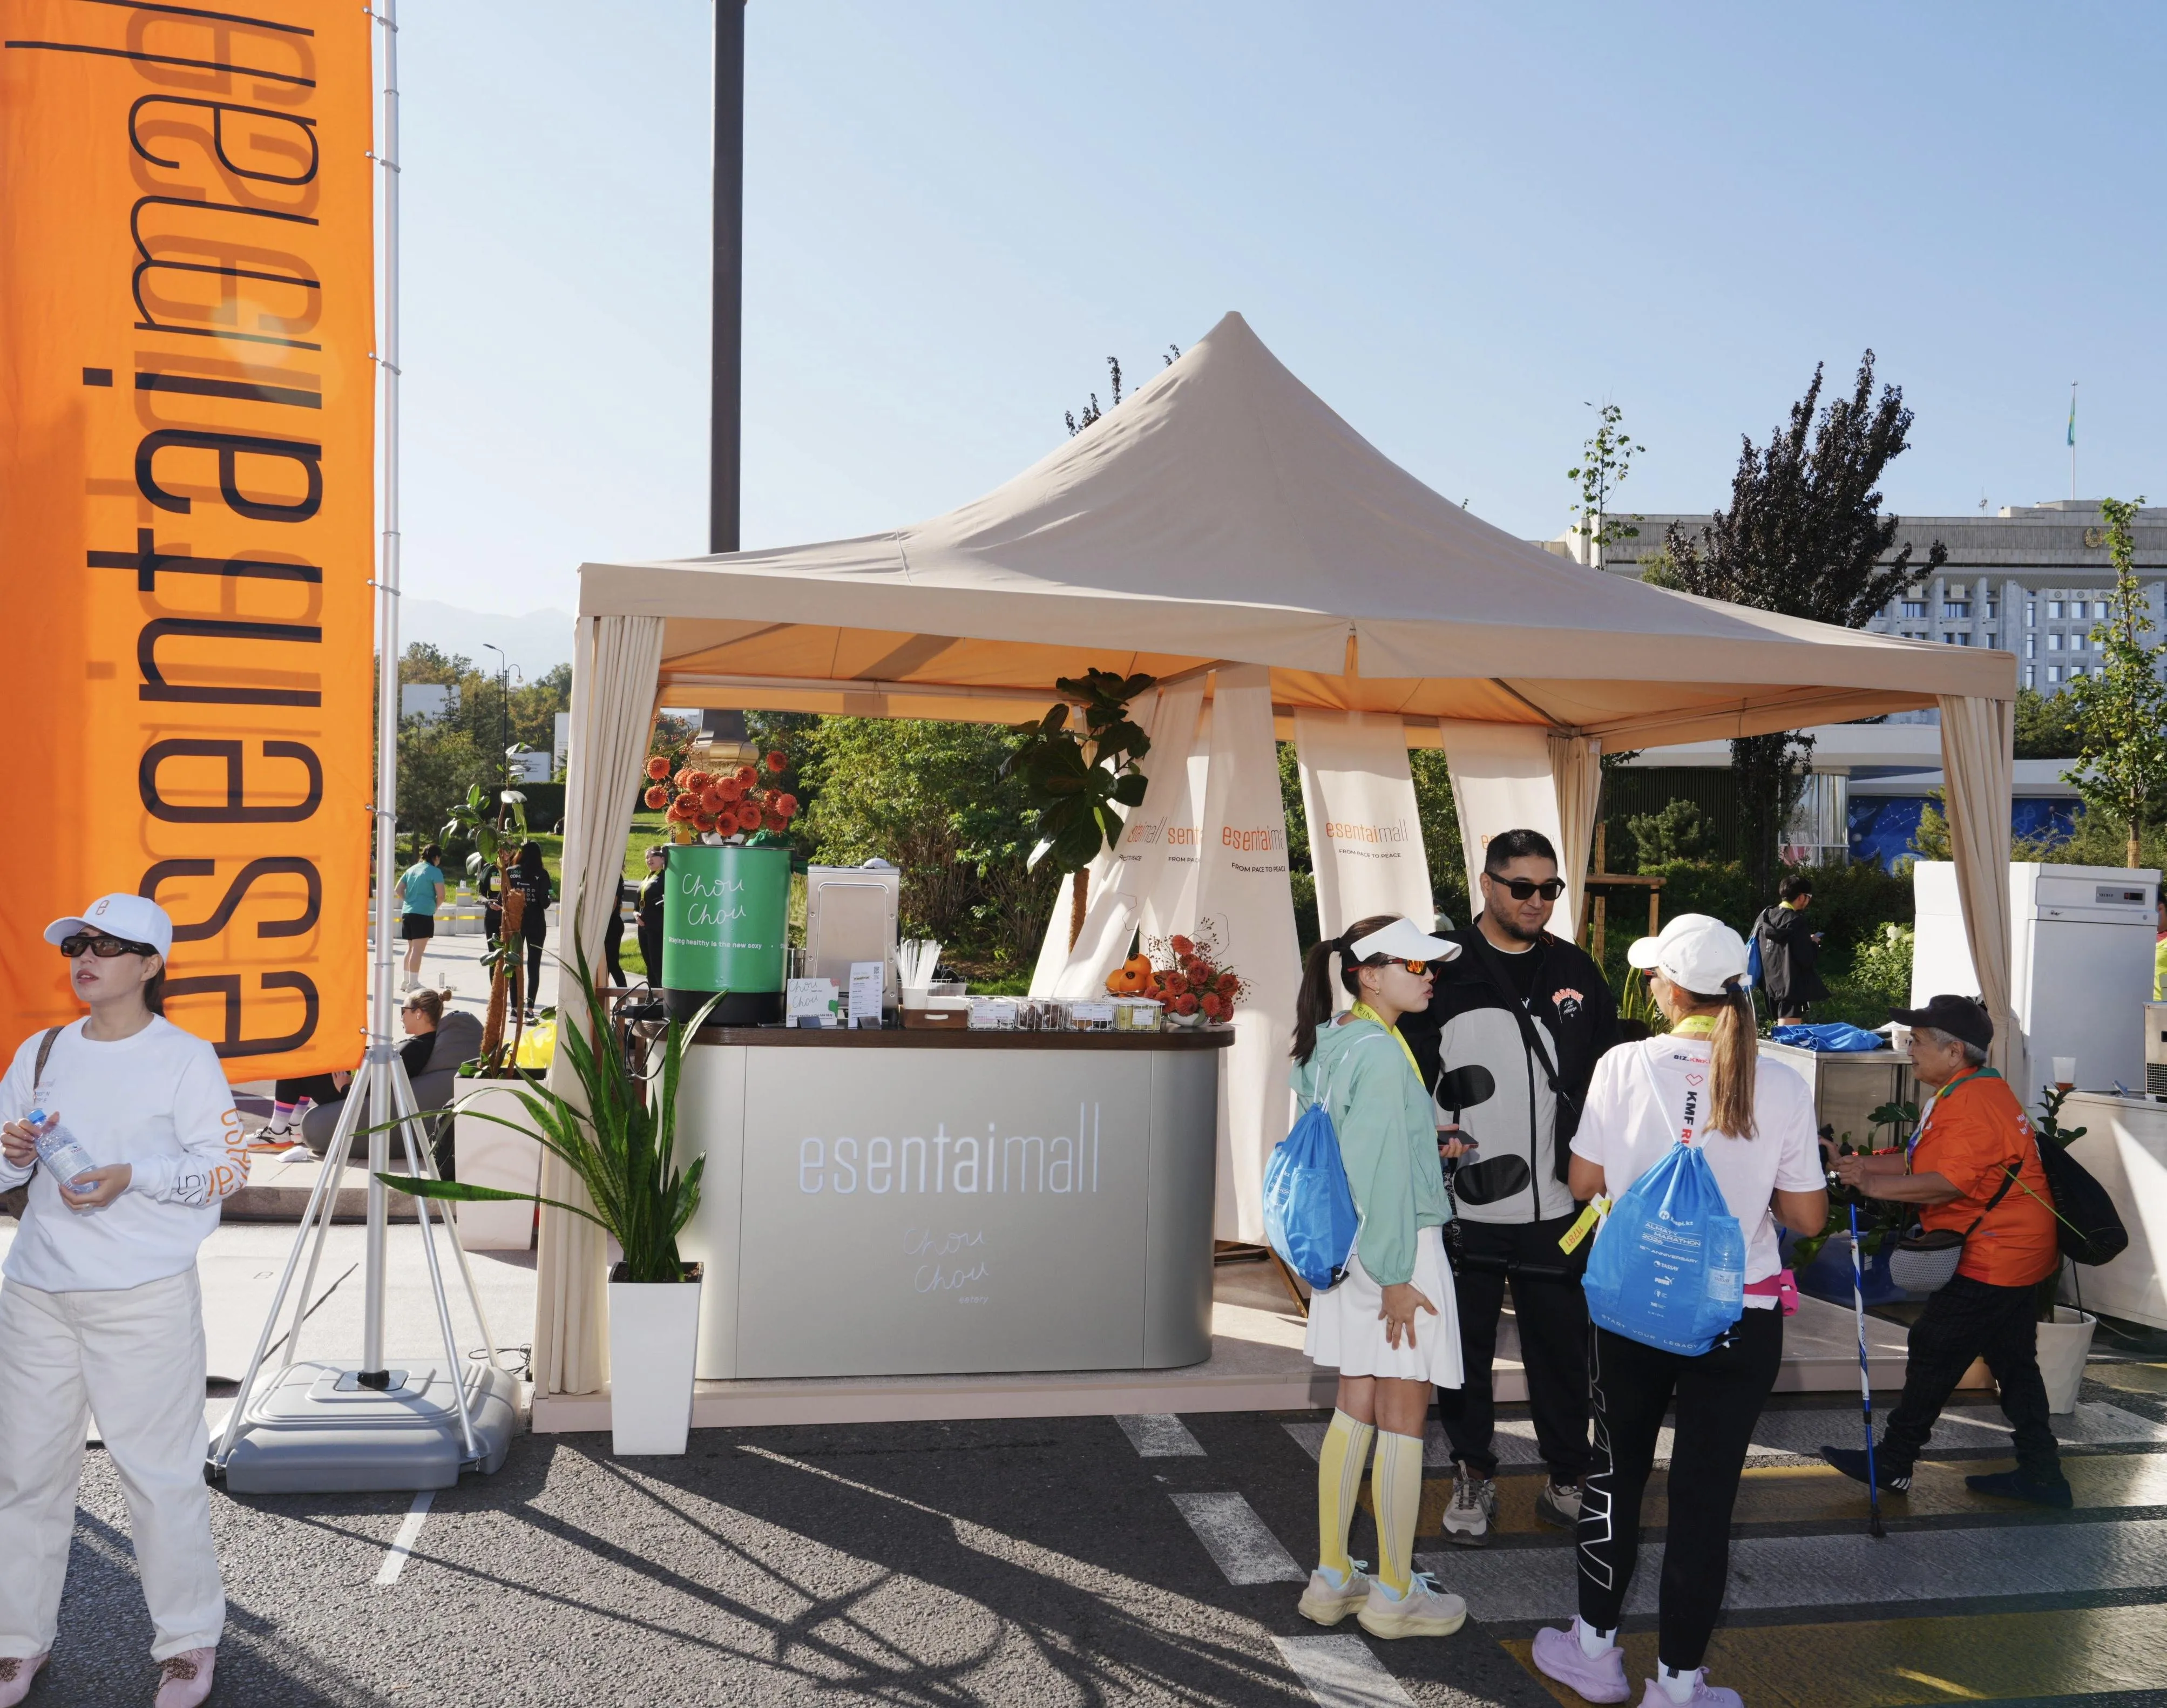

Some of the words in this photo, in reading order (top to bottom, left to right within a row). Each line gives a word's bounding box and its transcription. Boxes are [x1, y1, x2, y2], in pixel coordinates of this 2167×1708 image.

[1325, 818, 1408, 843] esentaimall
[1231, 862, 1250, 872] FROM
[682, 873, 744, 897] Chou
[688, 903, 747, 926] Chou
[669, 937, 685, 945] Staying
[686, 938, 709, 948] healthy
[789, 980, 817, 993] Chou
[792, 995, 818, 1008] Chou
[1684, 1090, 1698, 1126] KMF
[799, 1101, 1099, 1194] esentaimall
[1644, 1222, 1678, 1236] ALMATY
[1654, 1231, 1701, 1246] MARATHON
[903, 1226, 985, 1257] Chou
[1651, 1249, 1698, 1263] ANNIVERSARY
[1661, 1263, 1679, 1271] TASSAY
[914, 1262, 990, 1293] Chou
[1601, 1313, 1626, 1329] START
[1631, 1329, 1656, 1340] YOUR
[1663, 1339, 1698, 1349] LEGACY
